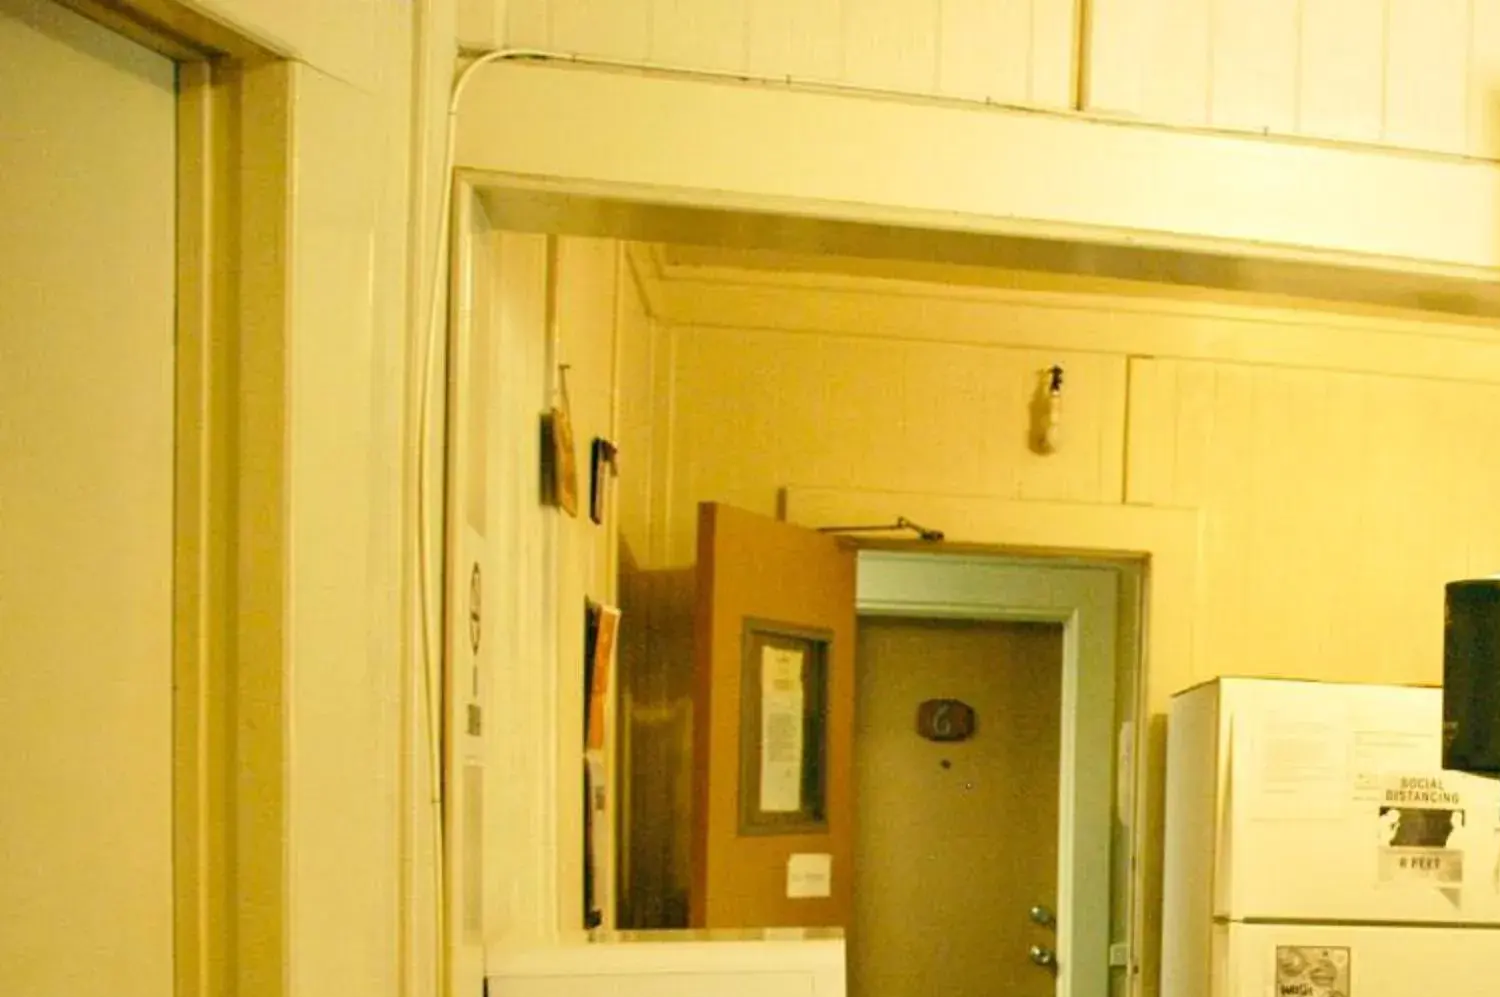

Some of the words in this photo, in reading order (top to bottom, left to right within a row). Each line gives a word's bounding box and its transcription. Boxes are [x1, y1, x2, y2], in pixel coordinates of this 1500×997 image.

[933, 703, 951, 736] 6
[1400, 777, 1444, 790] SOCIAL
[1385, 789, 1460, 804] DISTANCING
[1411, 857, 1440, 869] FEET
